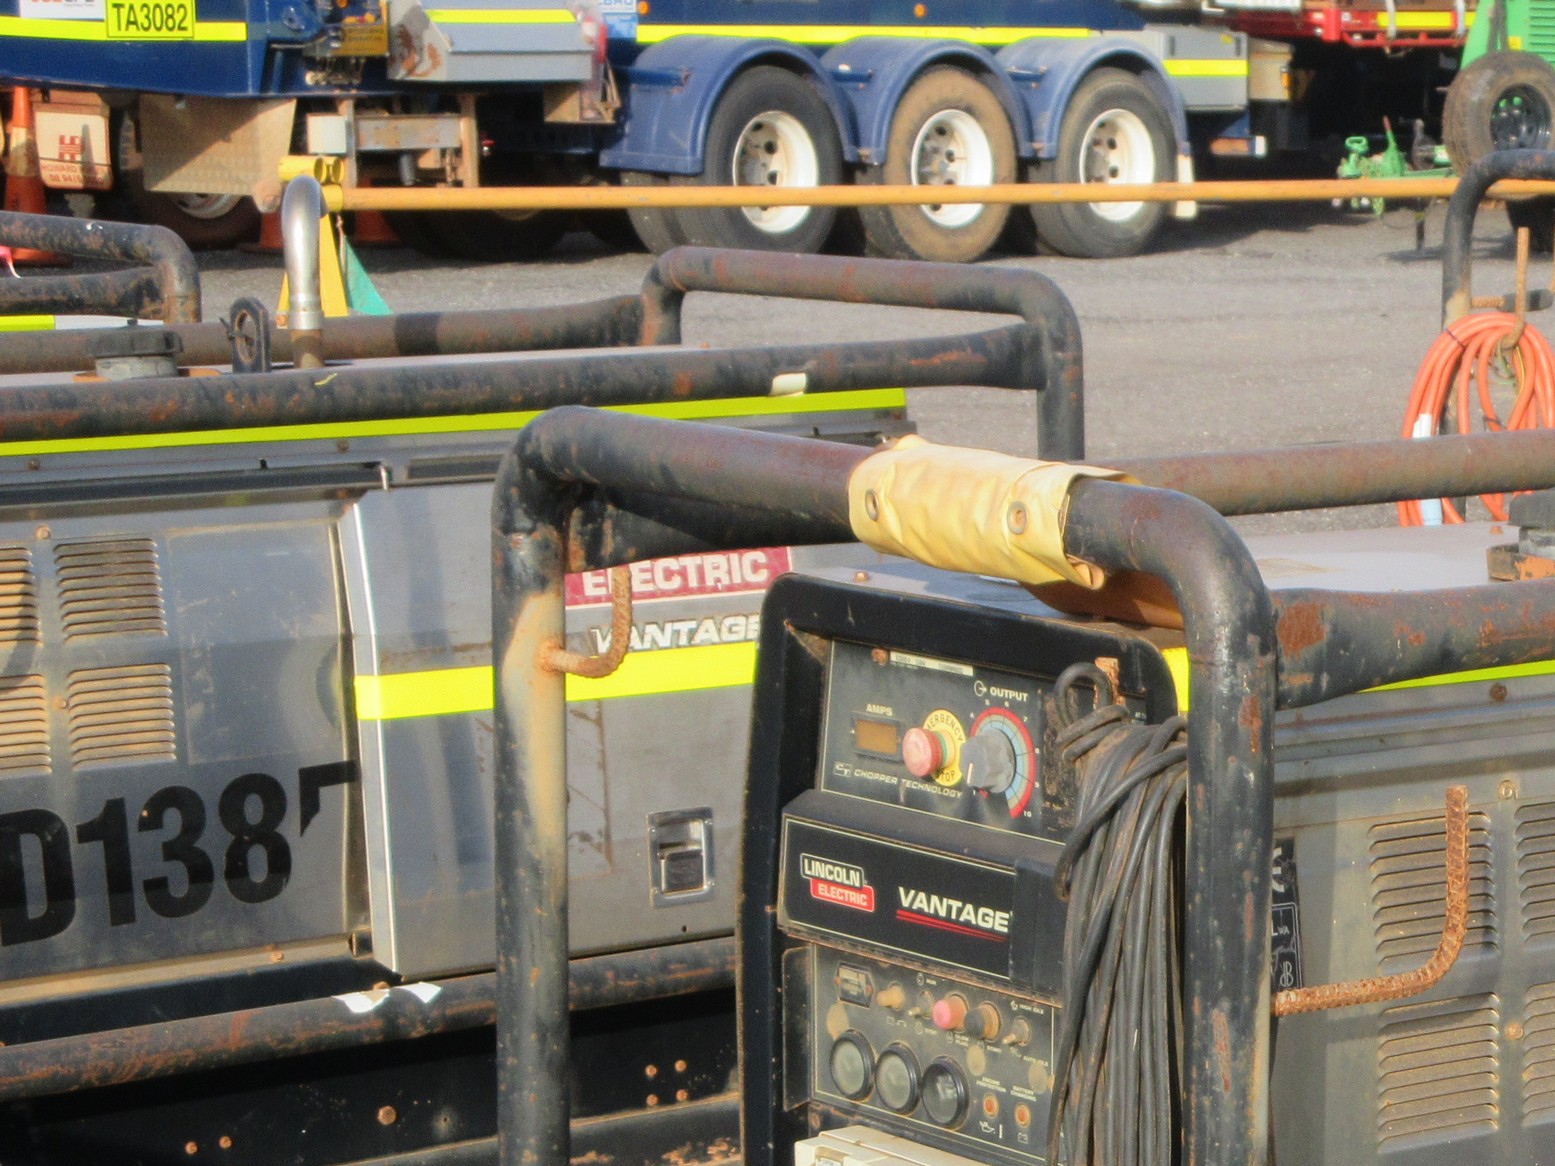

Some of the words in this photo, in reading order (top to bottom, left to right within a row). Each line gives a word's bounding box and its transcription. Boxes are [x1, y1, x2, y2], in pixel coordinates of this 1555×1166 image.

[112, 3, 188, 31] TA3082
[989, 686, 1028, 702] OUTPUT
[866, 703, 893, 716] AMPS
[854, 768, 899, 785] CHOPPER
[901, 778, 963, 799] TECHNOLOGY
[803, 858, 861, 888] LINCOLN
[817, 883, 868, 906] ELECTRIC
[898, 886, 1009, 933] VANTAGE
